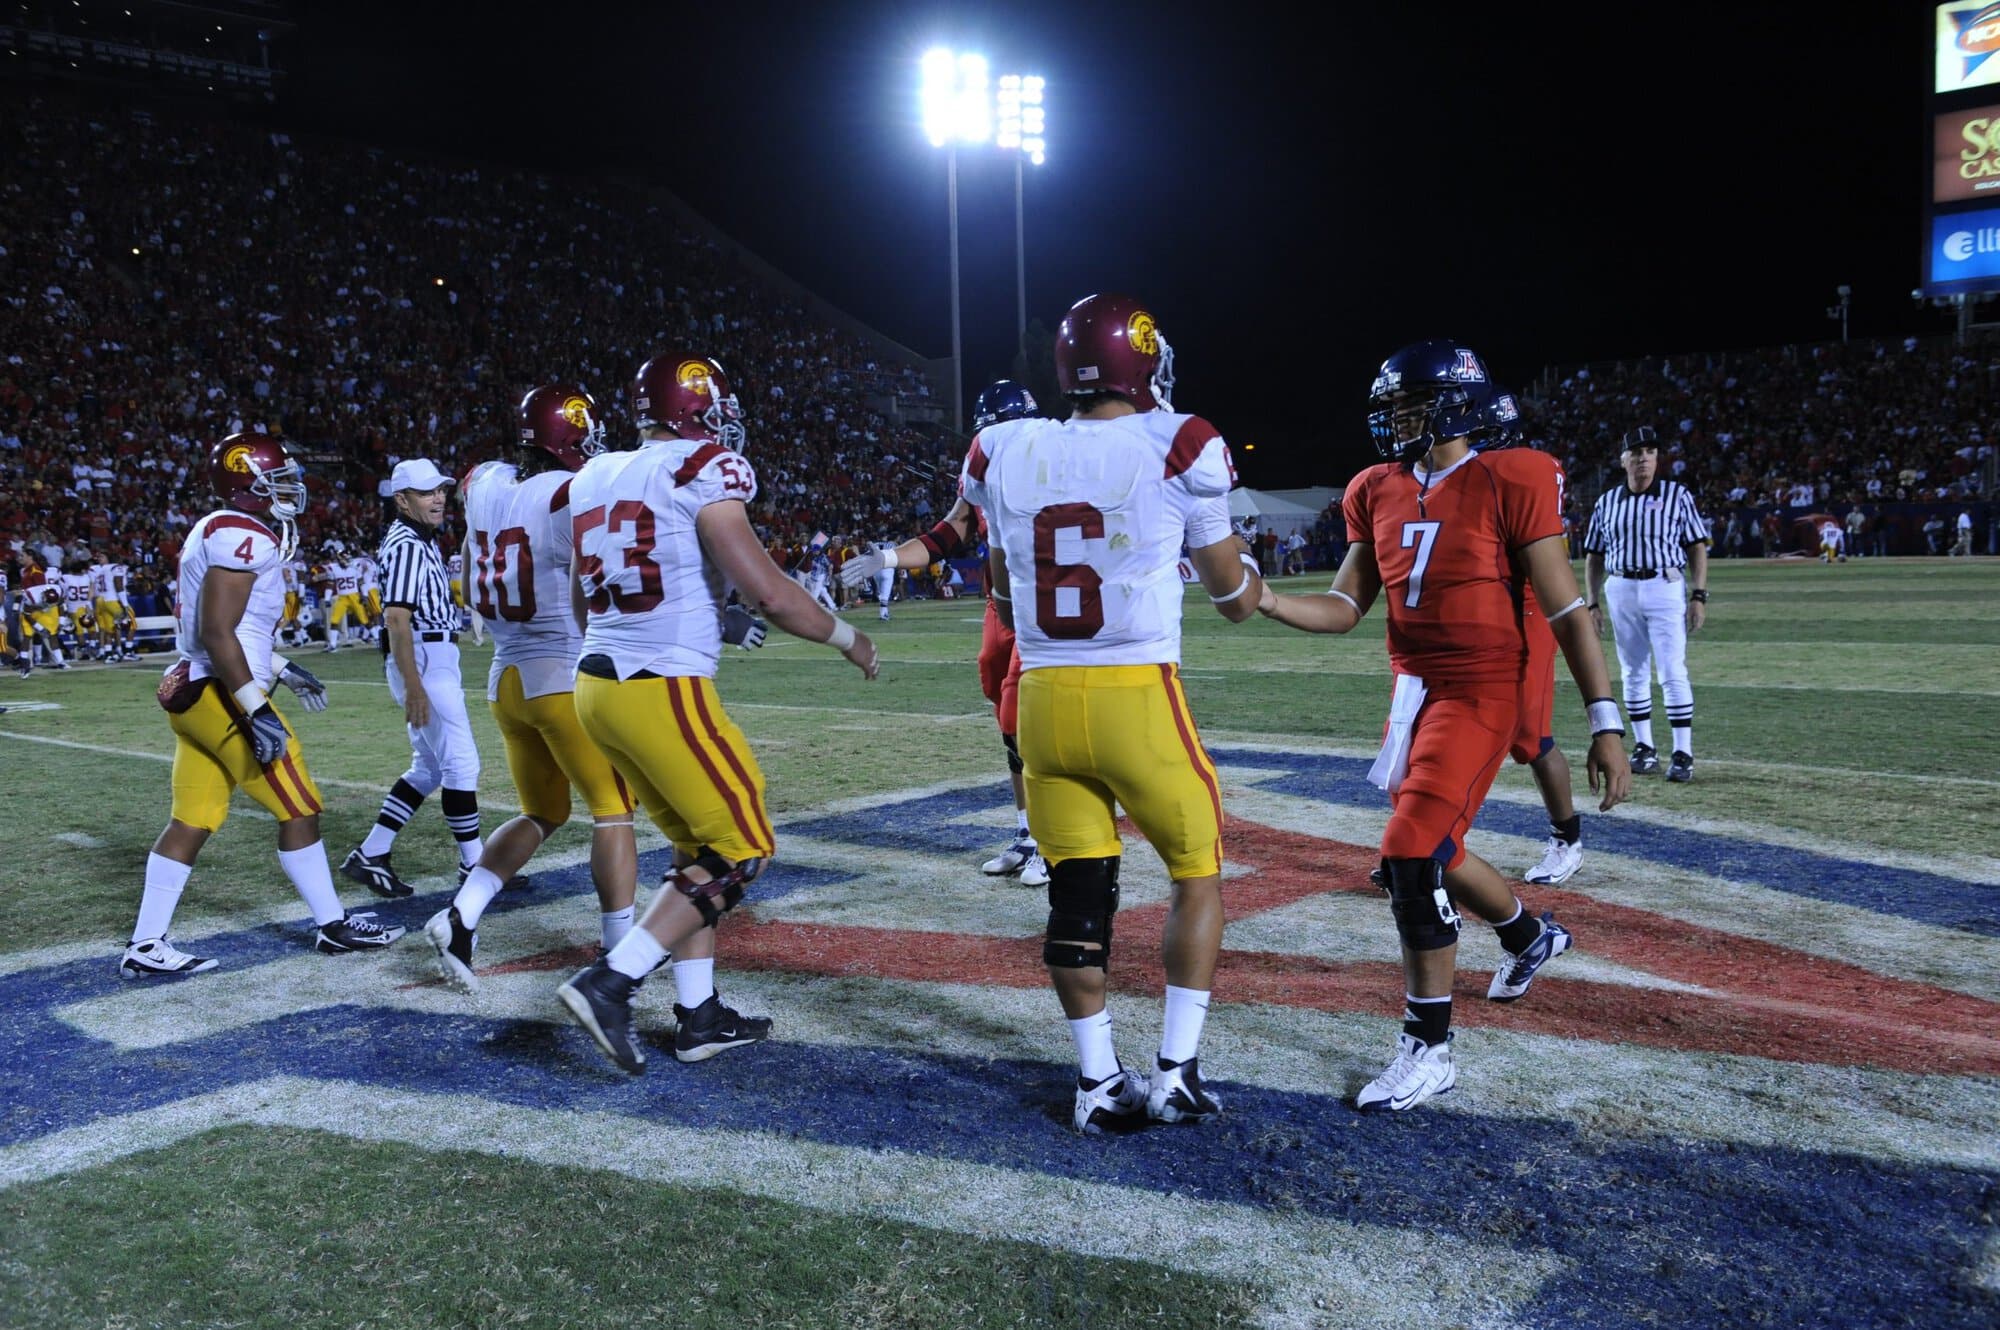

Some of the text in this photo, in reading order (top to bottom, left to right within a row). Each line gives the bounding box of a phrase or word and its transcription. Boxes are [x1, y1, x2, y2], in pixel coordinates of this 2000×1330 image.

[1455, 349, 1485, 382] A
[1499, 395, 1518, 422] A
[716, 457, 753, 491] 53
[234, 536, 253, 564] 4
[573, 500, 665, 614] 53
[1401, 521, 1443, 609] 7
[336, 576, 356, 590] 25
[475, 526, 537, 622] 10
[1033, 502, 1104, 640] 6
[68, 585, 89, 601] 35
